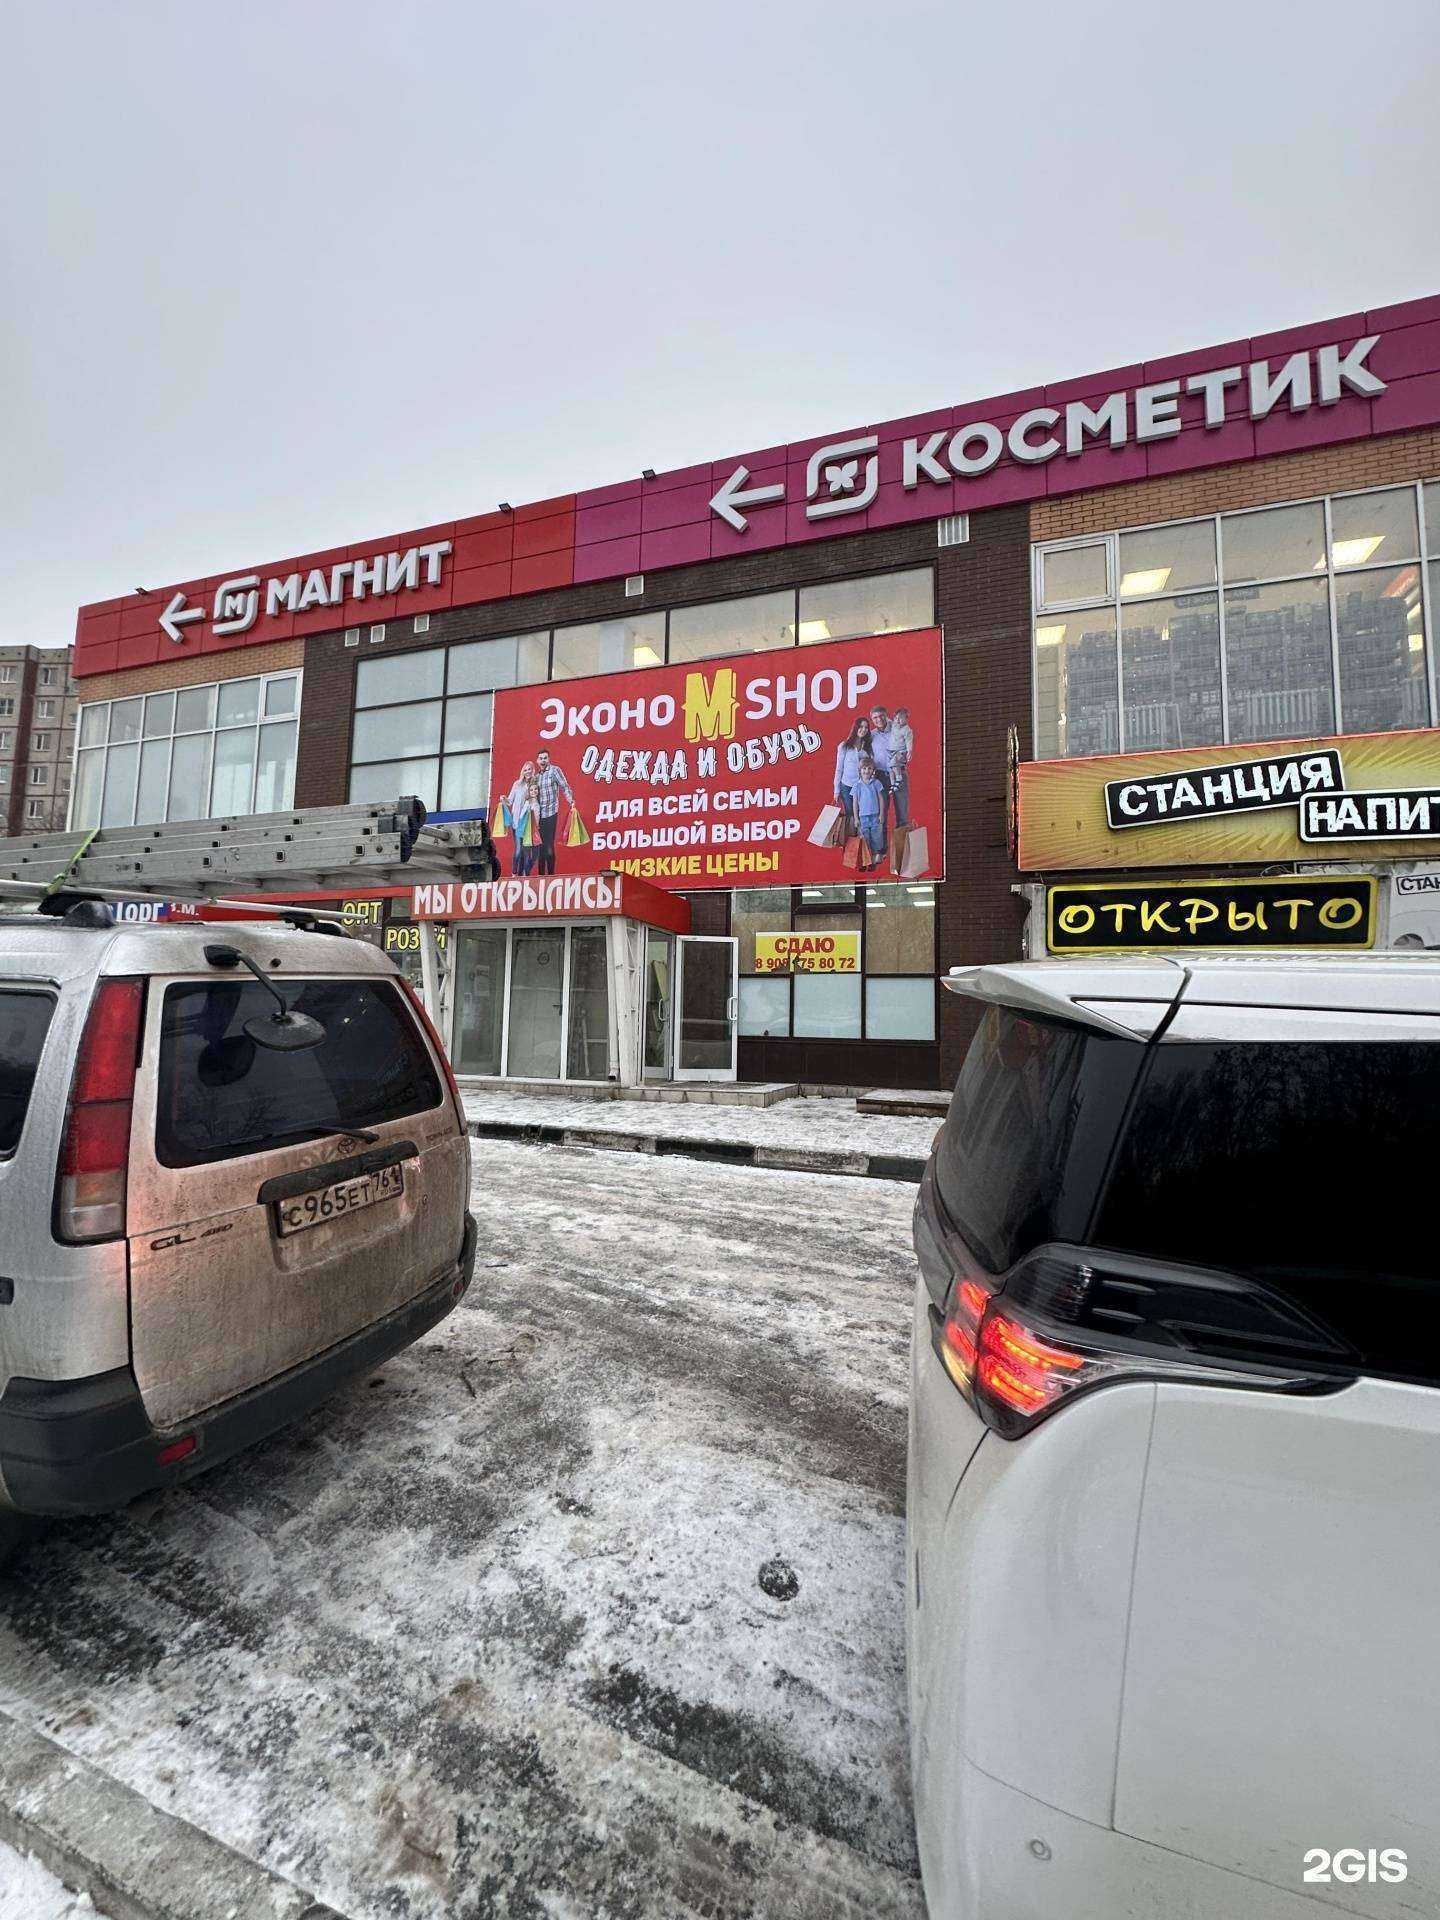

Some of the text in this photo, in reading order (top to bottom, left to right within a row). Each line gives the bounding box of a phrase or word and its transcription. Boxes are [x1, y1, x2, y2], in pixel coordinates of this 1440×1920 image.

[903, 334, 1389, 492] КОСМЕТИК
[266, 541, 453, 616] МАГНИТ
[746, 665, 878, 720] SHOP
[580, 724, 822, 785] ОДЕЖДА И ОБУВЬ
[596, 786, 798, 823] ДЛЯ ВСЕЙ СЕМЬИ
[1118, 756, 1335, 817] СТАНЦИЯ
[592, 819, 801, 851] БОЛЬШОЙ ВЫБОР
[610, 851, 780, 878] НИЗКИЕ ЦЕНЫ
[341, 900, 383, 926] ОПТ
[414, 875, 622, 915] МЫ ОТКРЫЛИСЬ!
[1058, 897, 1364, 935] ОТКРЫТО
[774, 937, 835, 954] СДАЮ
[818, 957, 835, 969] 80
[838, 957, 856, 969] 72
